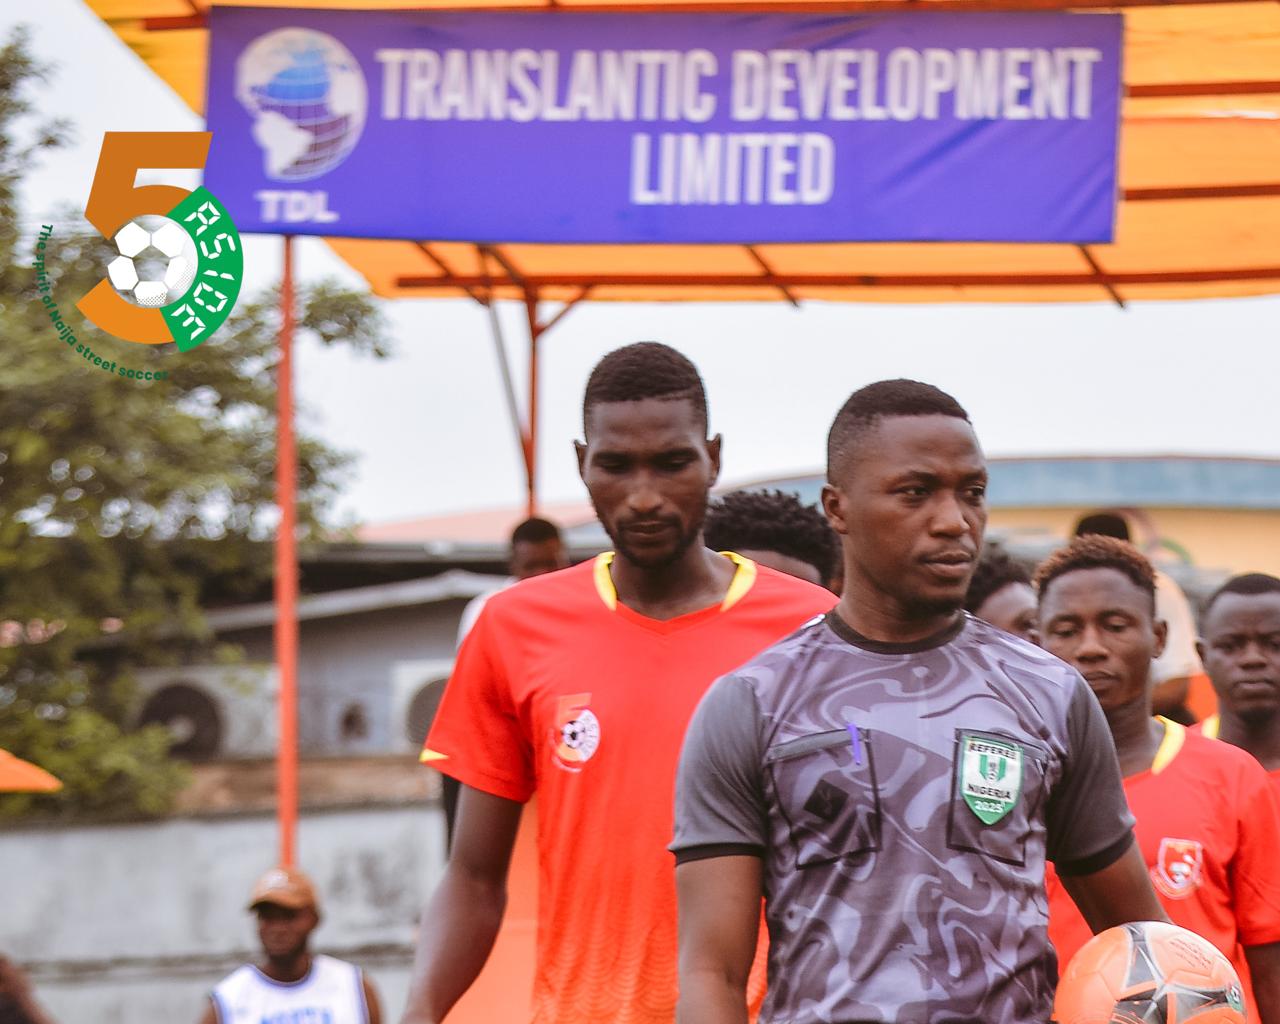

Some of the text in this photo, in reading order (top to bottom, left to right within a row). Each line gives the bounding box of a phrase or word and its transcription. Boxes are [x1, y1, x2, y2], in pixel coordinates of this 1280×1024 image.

[375, 47, 1101, 122] TRANSLANTIC DEVELOPMENT
[631, 132, 835, 205] LIMITED
[254, 189, 340, 223] TDL
[968, 784, 1012, 799] NIGERIA
